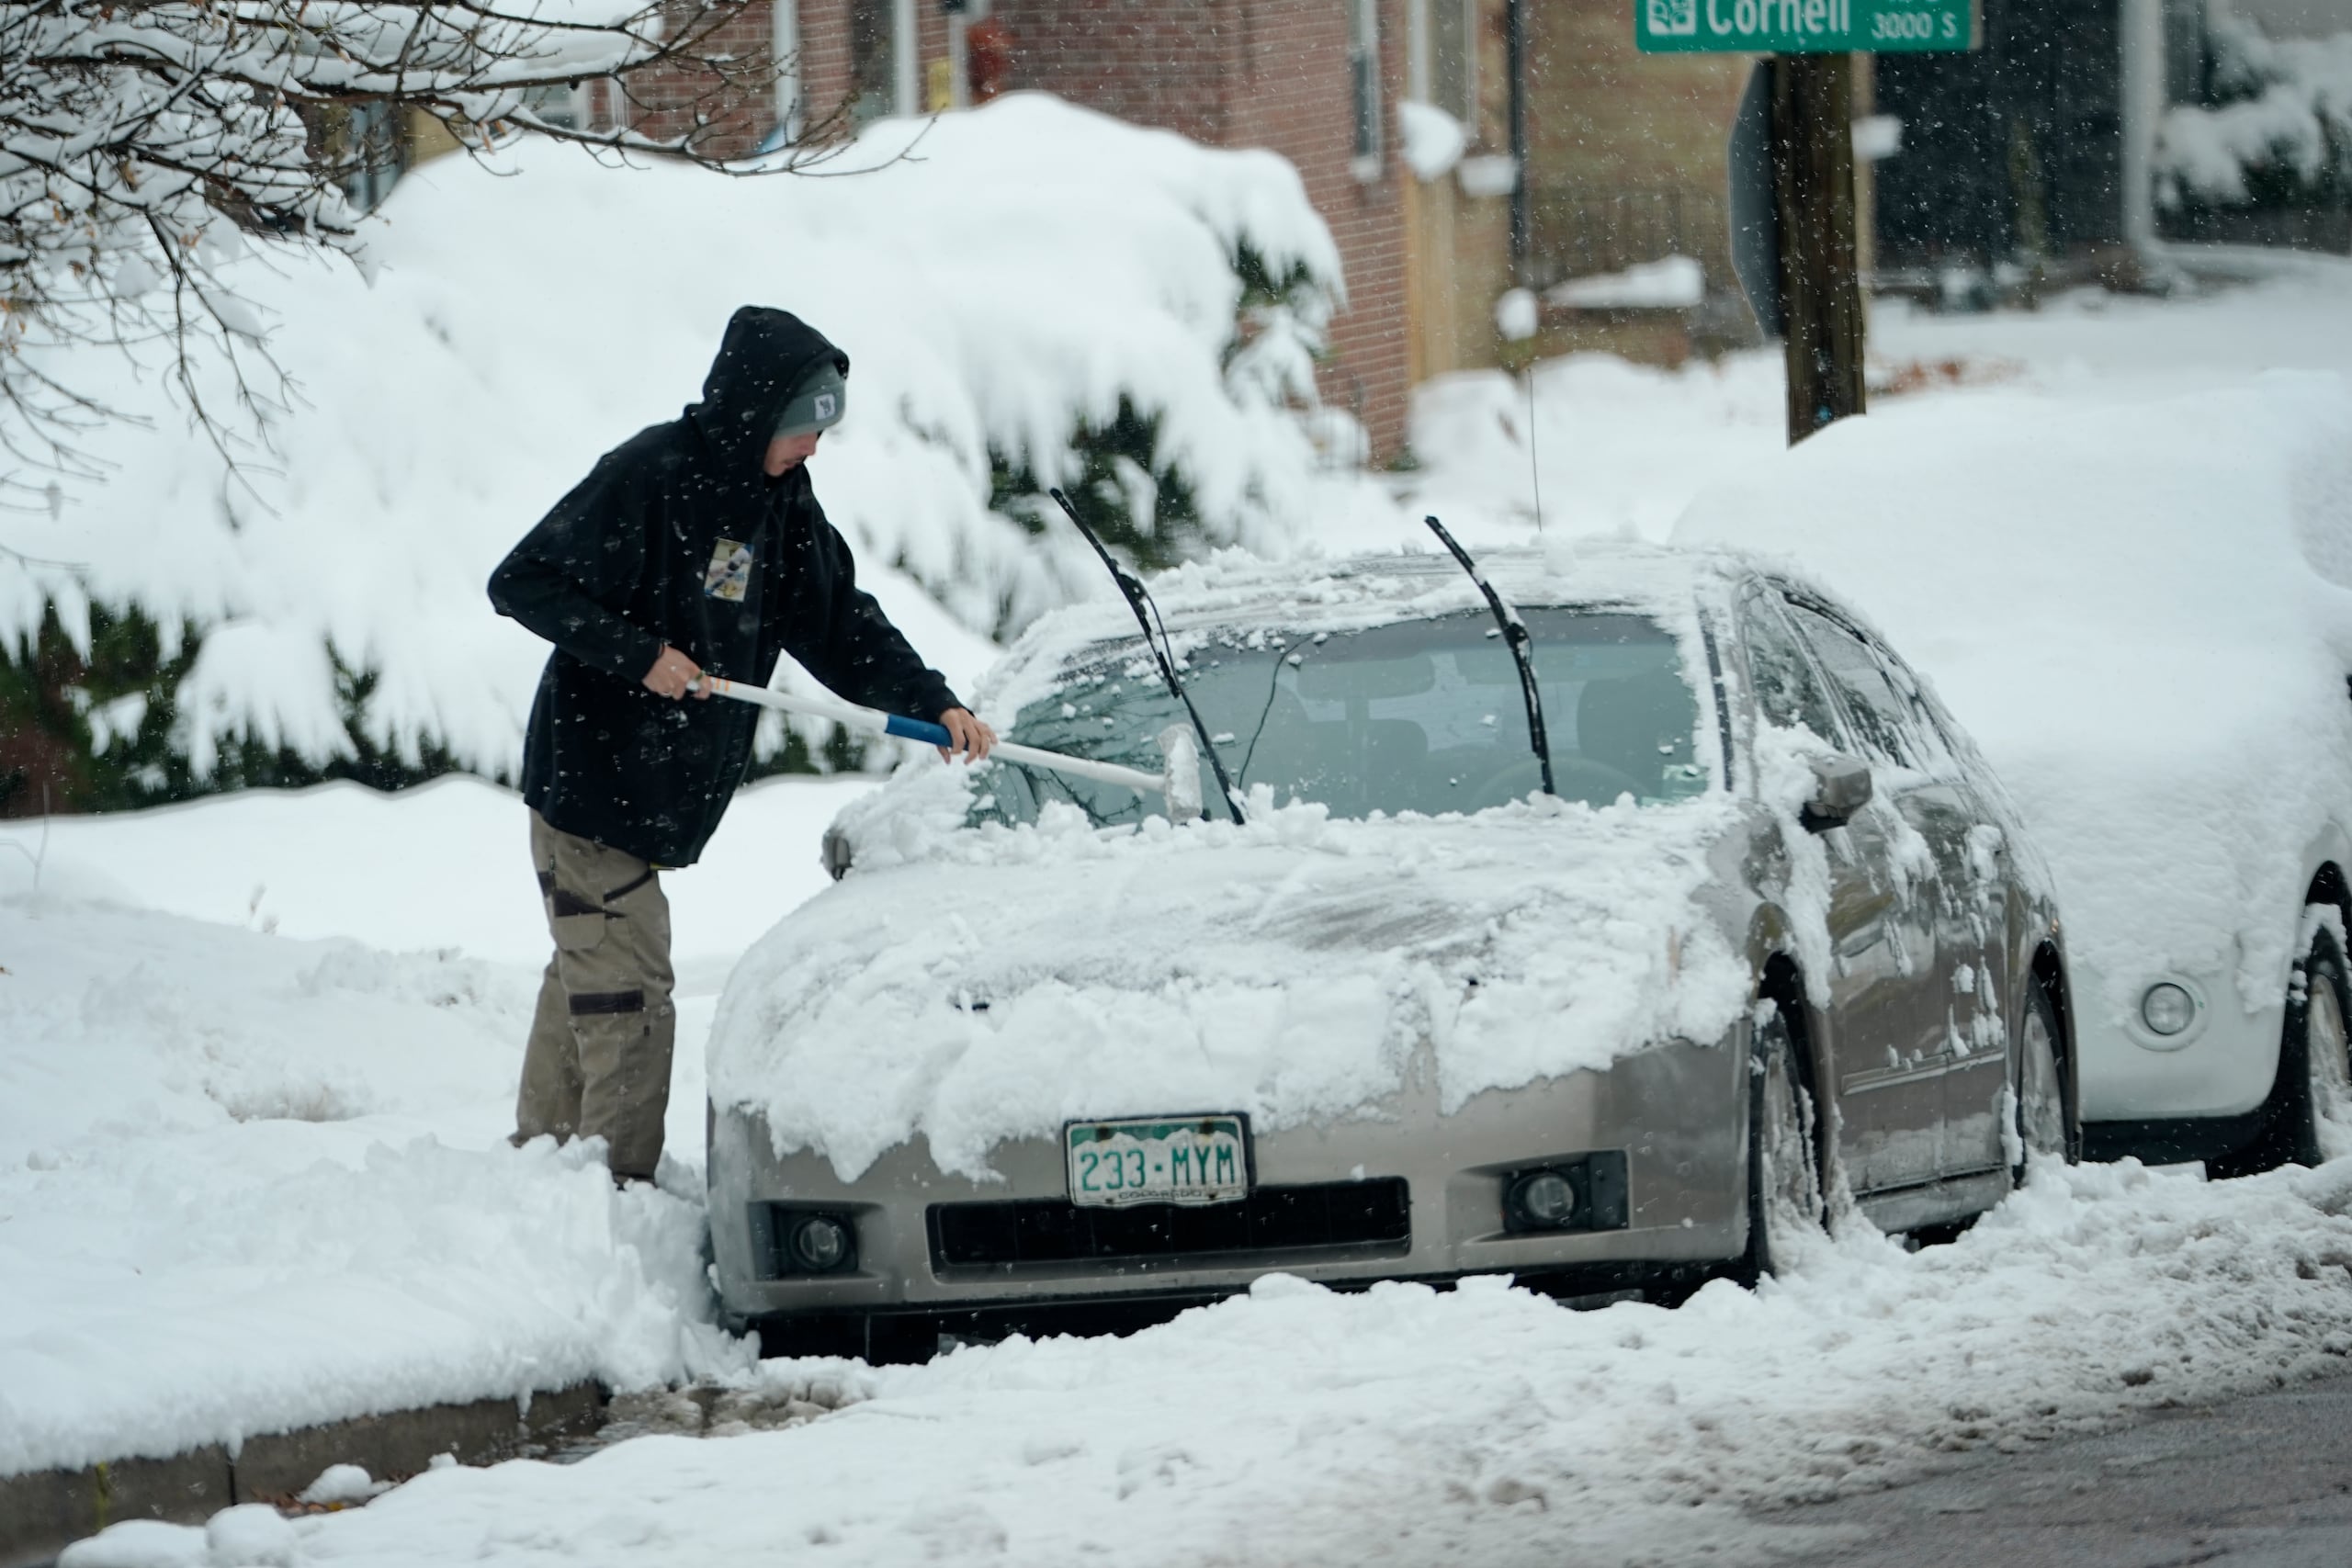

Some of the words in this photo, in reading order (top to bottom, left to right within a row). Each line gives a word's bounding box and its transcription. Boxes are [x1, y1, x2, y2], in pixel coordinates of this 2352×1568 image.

[1705, 0, 1850, 35] Cornell
[1871, 11, 1933, 39] 3000
[1940, 11, 1958, 39] S
